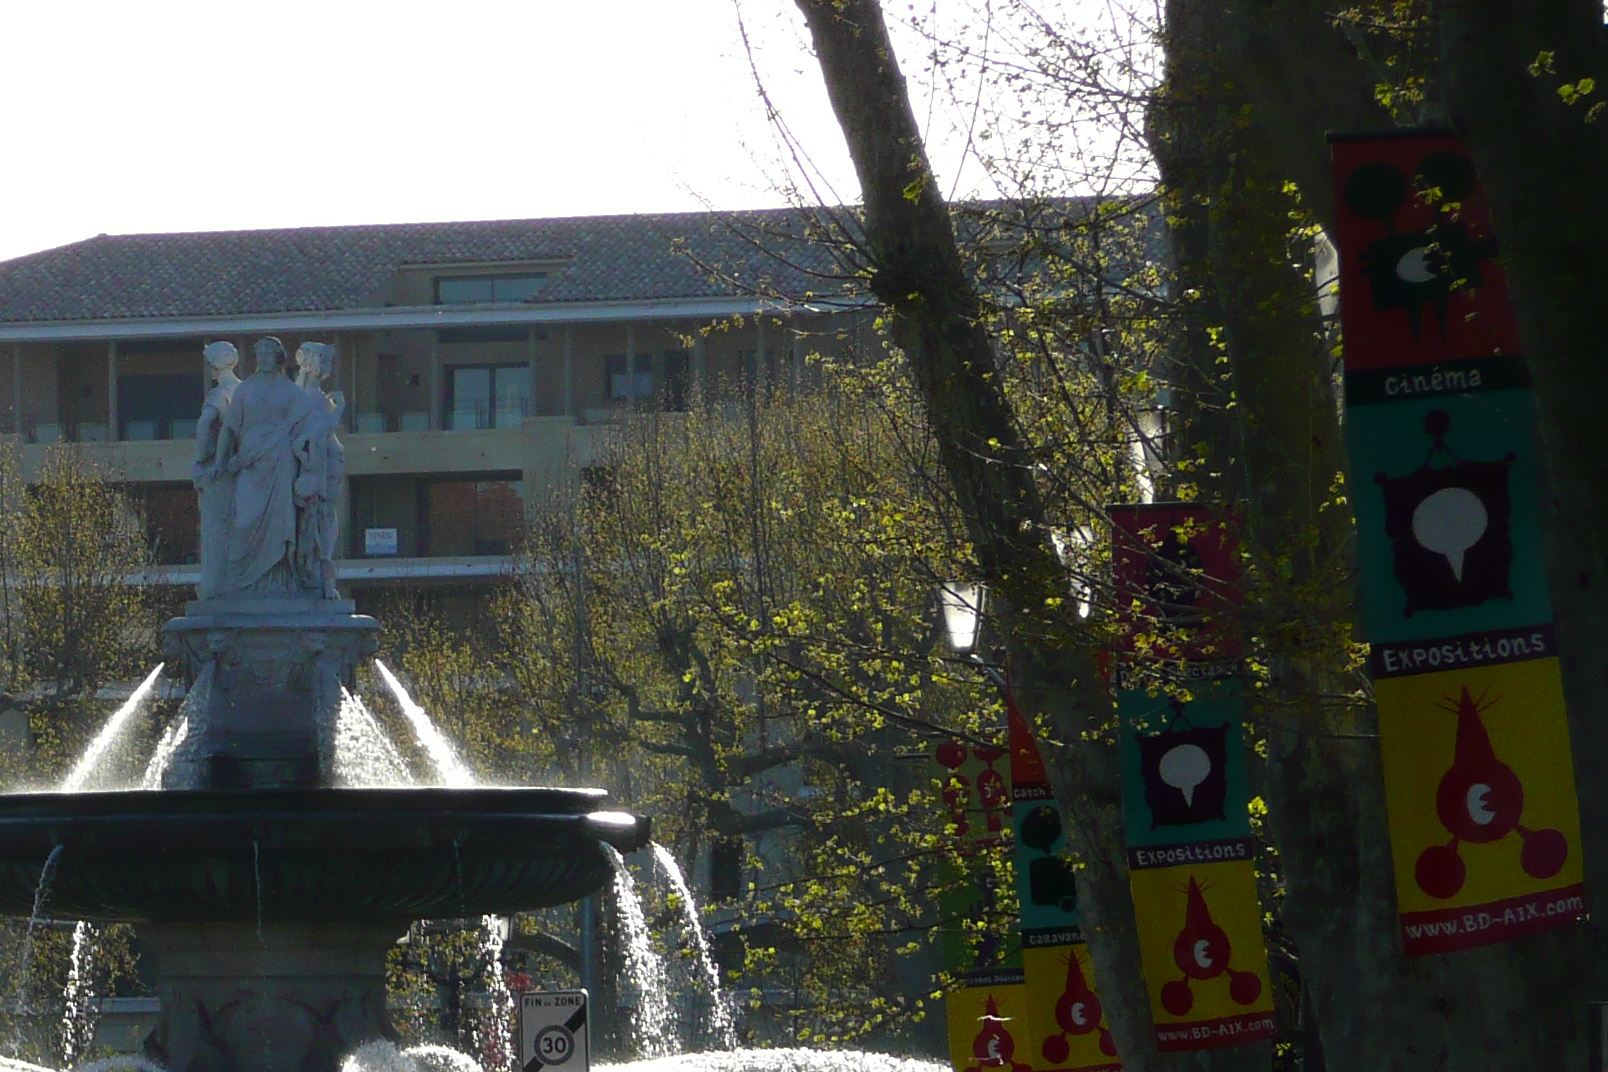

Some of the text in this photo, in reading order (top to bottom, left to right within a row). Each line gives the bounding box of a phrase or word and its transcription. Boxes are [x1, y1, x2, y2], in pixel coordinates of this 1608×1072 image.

[1384, 366, 1483, 396] Cinéma
[525, 998, 541, 1007] FIN
[554, 997, 581, 1006] ZONE
[543, 1037, 566, 1053] 30
